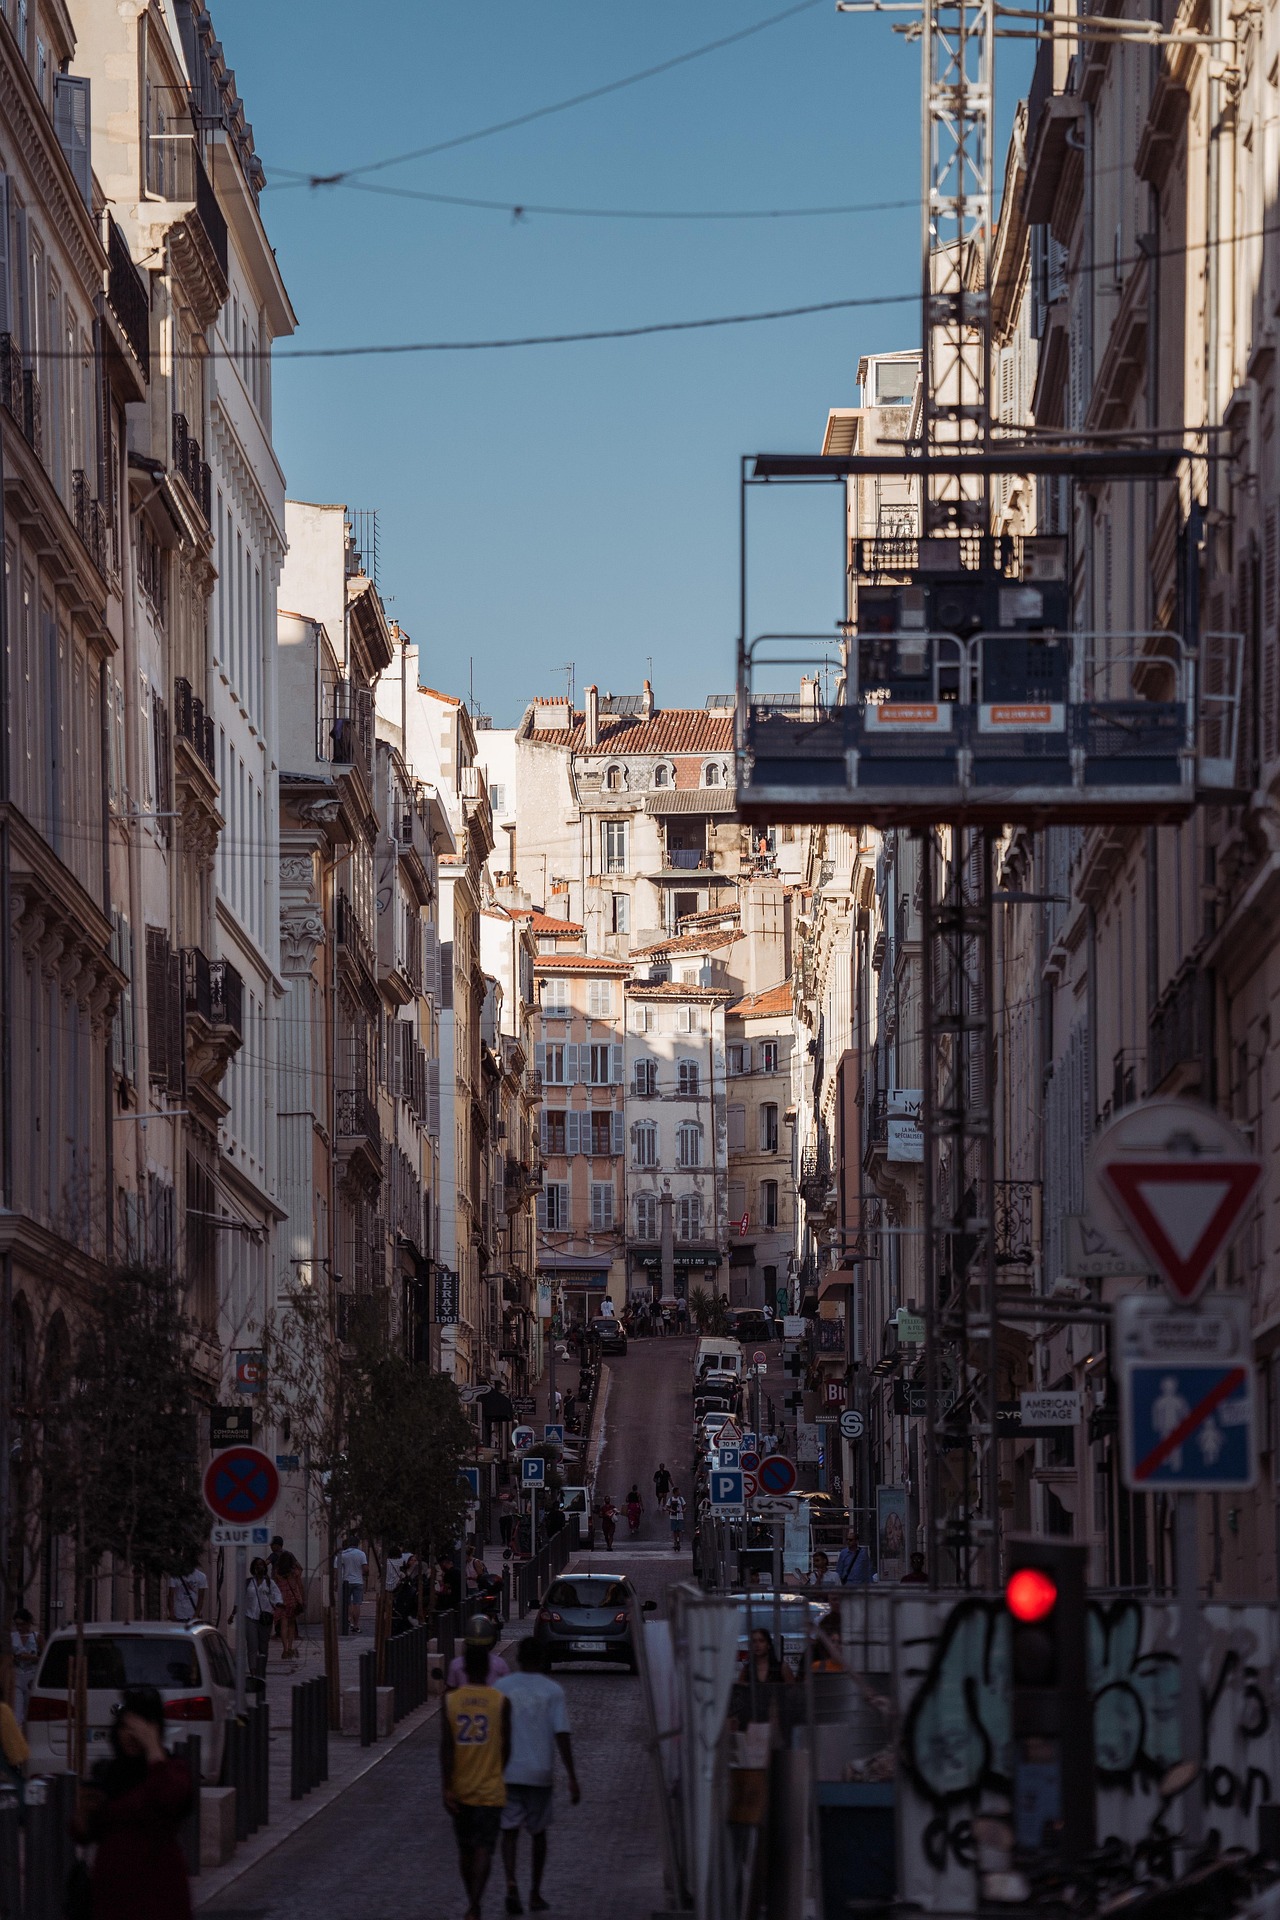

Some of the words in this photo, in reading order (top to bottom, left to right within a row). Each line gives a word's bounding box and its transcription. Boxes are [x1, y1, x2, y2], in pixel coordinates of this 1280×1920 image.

[441, 1273, 453, 1315] LERAY
[436, 1316, 458, 1324] 1901
[1025, 1399, 1077, 1409] AMERICAN
[1030, 1409, 1073, 1419] VINTAGE
[724, 1452, 734, 1465] P
[528, 1463, 538, 1477] P
[719, 1477, 735, 1499] P
[214, 1531, 249, 1542] SAUF
[457, 1714, 488, 1744] 23
